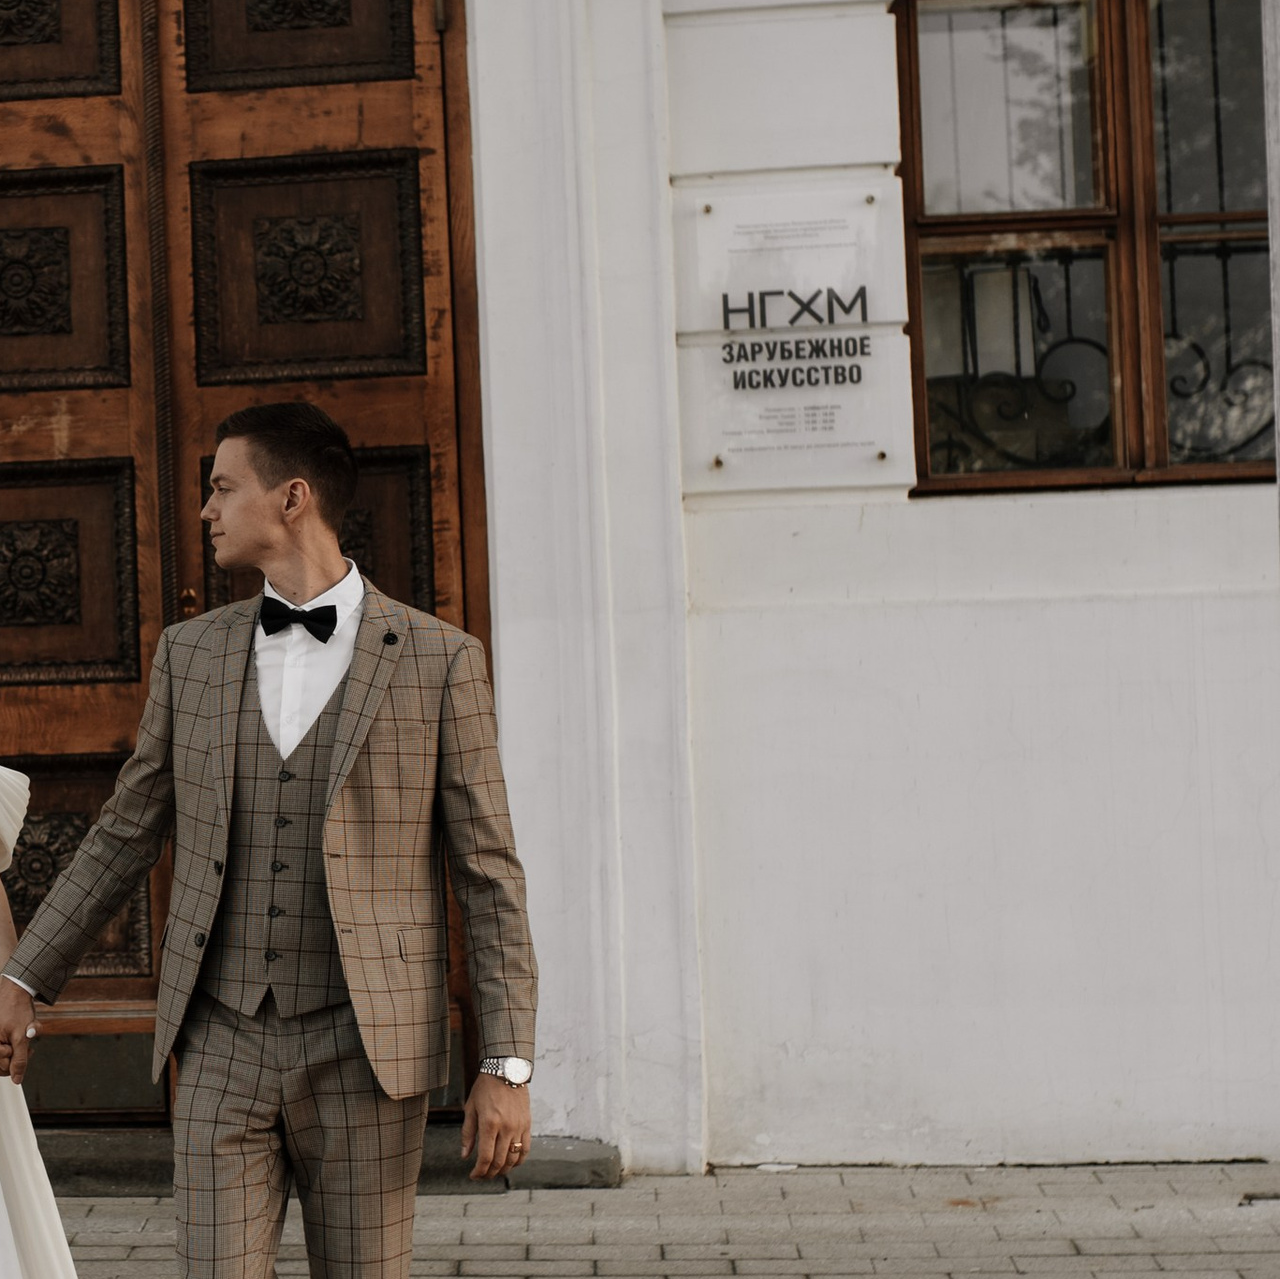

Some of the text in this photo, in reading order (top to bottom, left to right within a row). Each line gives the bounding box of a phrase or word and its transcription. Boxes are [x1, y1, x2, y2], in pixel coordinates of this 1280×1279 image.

[721, 285, 868, 330] НГХМ
[721, 336, 872, 364] ЗАРУБЕЖНОЕ
[732, 363, 863, 390] ИСКУССТВО
